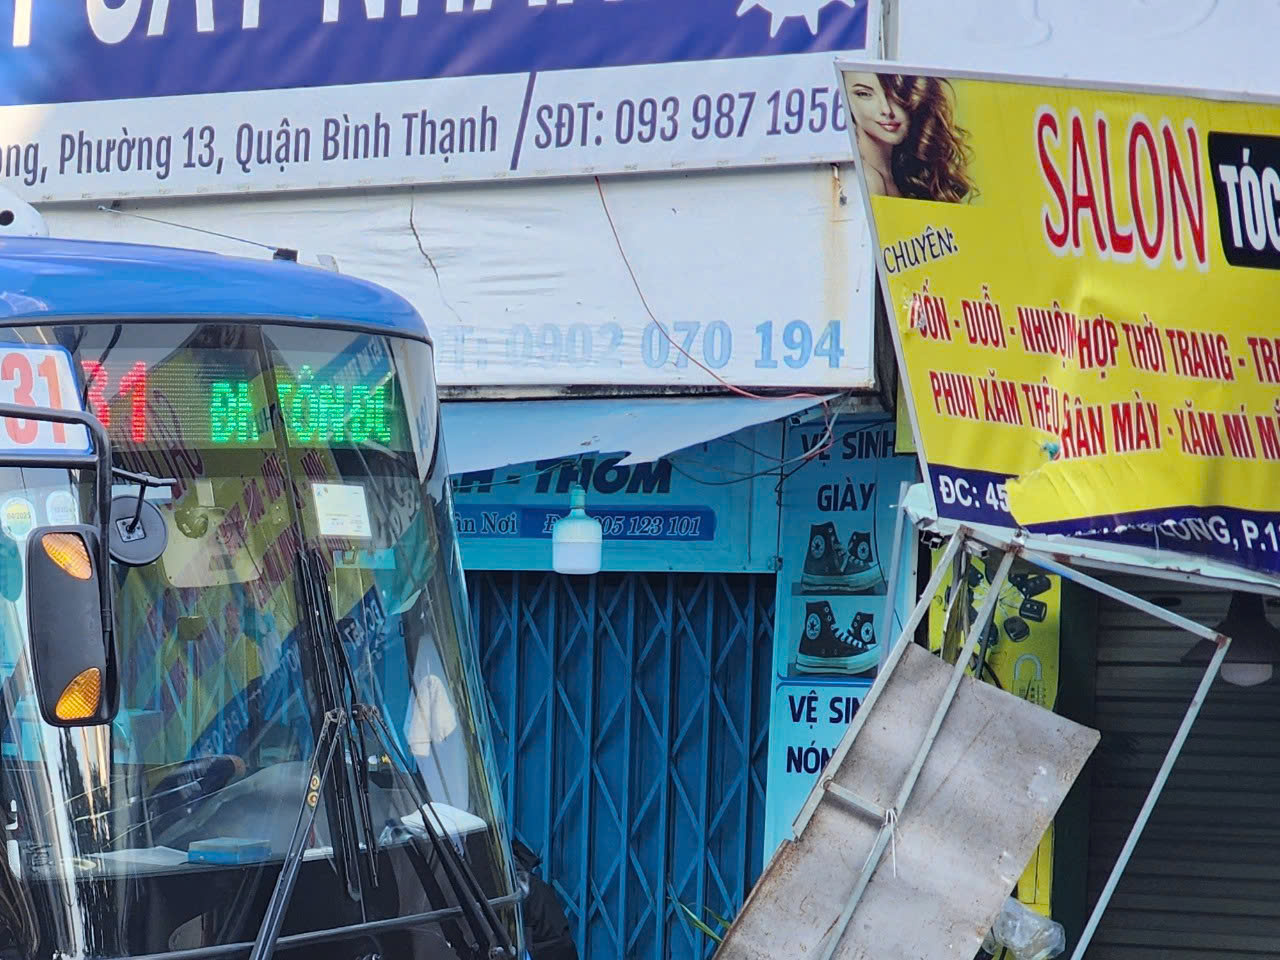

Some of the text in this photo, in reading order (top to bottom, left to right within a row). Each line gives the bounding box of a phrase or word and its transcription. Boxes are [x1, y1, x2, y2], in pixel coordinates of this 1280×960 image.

[59, 127, 172, 181] Phường
[182, 125, 224, 175] 13,
[236, 117, 311, 174] Quận
[322, 112, 391, 162] Bình
[402, 105, 498, 164] Thạnh
[534, 102, 604, 150] SĐT:
[615, 96, 680, 145] 093
[691, 91, 757, 141] 987
[766, 86, 848, 136] 1956
[1035, 107, 1209, 269] SALON
[1219, 147, 1280, 252] TÓC
[883, 225, 958, 274] CHUYÊN:
[640, 319, 733, 370] 070
[753, 319, 846, 370] 194
[961, 284, 1008, 349] DUỖI
[1077, 313, 1120, 379] HỢP
[1121, 312, 1167, 373] THỜI
[1166, 328, 1235, 382] TRANG
[0, 352, 68, 446] 31
[929, 370, 980, 421] PHUN
[978, 368, 1024, 426] XĂM
[1021, 375, 1060, 436] THÊU
[1111, 390, 1162, 453] MÀY
[1174, 400, 1226, 457] XĂM
[1223, 404, 1257, 459] MÍ
[842, 430, 897, 460] SINH
[817, 476, 876, 512] GIÀY
[938, 474, 980, 508] ĐC:
[481, 511, 518, 534] Nơi
[628, 515, 665, 537] 123
[668, 515, 703, 537] 101
[788, 689, 819, 730] VỆ
